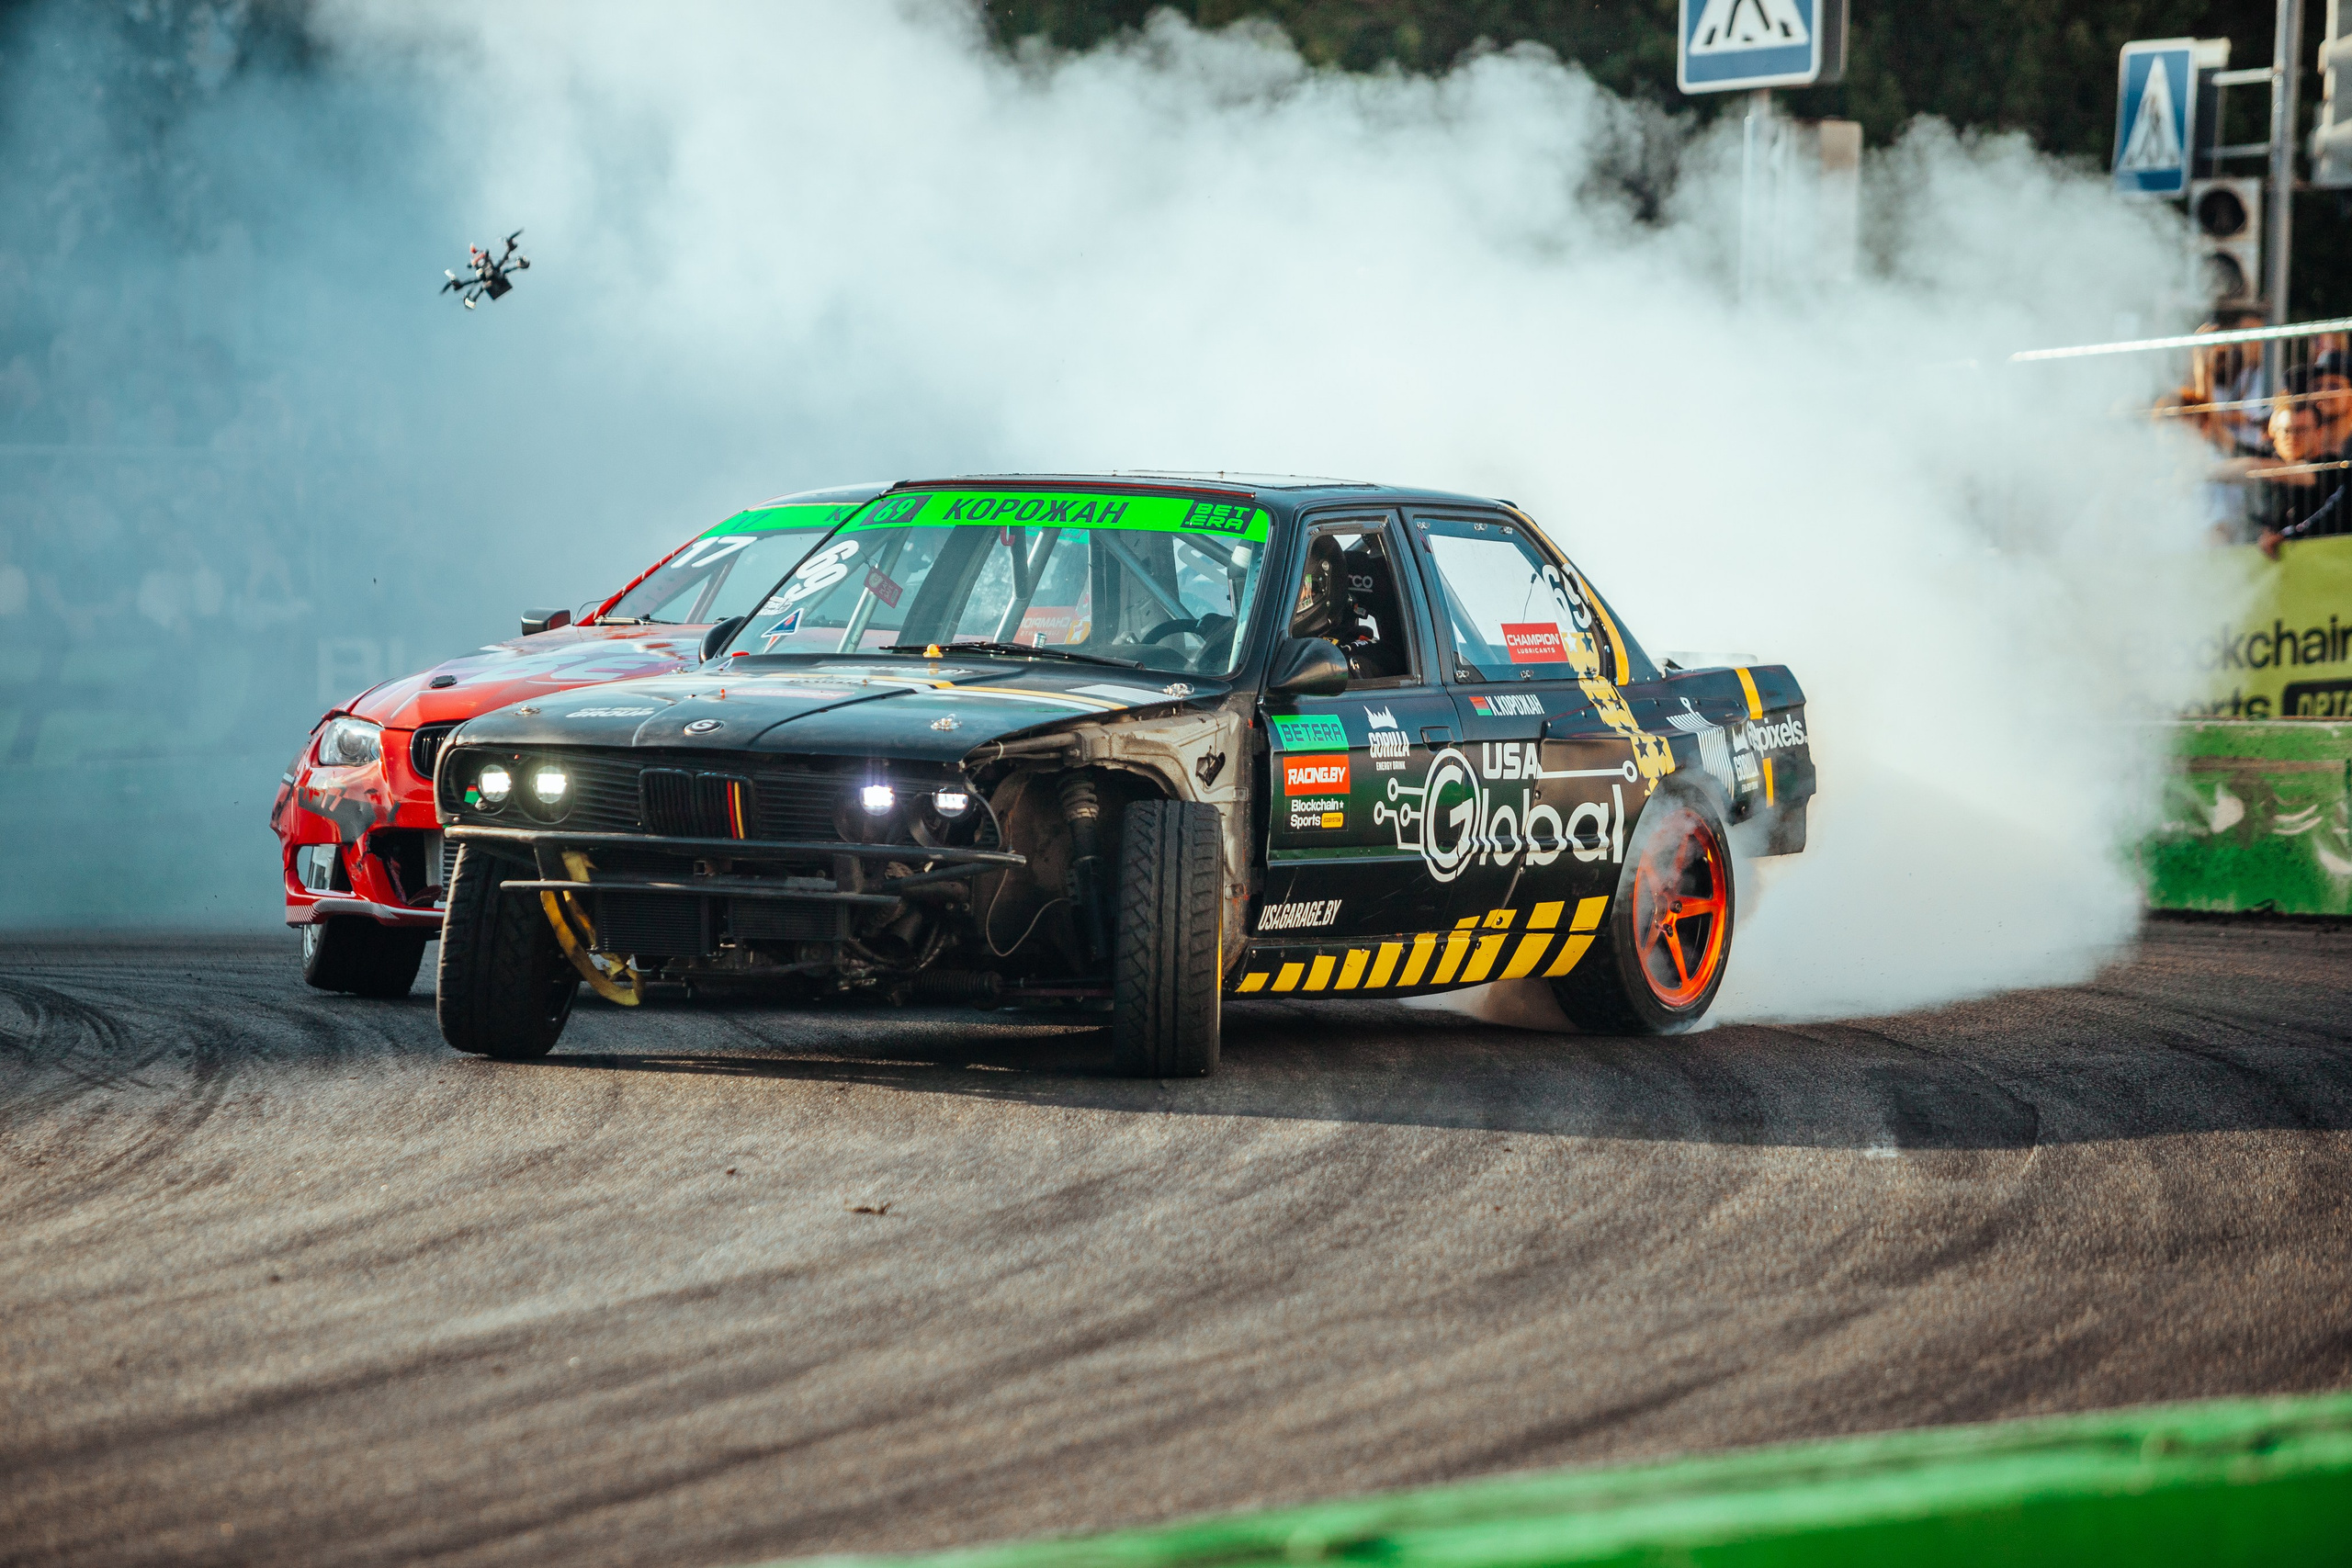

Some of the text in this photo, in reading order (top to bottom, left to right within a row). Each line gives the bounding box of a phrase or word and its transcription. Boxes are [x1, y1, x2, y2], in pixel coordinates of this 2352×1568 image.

[873, 498, 1130, 524] 69 КОРОЖАН
[1194, 502, 1250, 518] BET
[670, 536, 758, 569] 17
[784, 540, 860, 604] 69
[1543, 562, 1592, 629] 69
[1507, 633, 1560, 647] CHAMPION
[1368, 731, 1410, 758] GORILLA
[1375, 761, 1407, 771] ENERGY DRINK
[1482, 742, 1539, 780] USA
[1291, 797, 1339, 813] Blockchain
[1426, 765, 1624, 870] Global
[1290, 813, 1321, 829] Sports
[1258, 899, 1342, 931] USAGARAGE.BY
